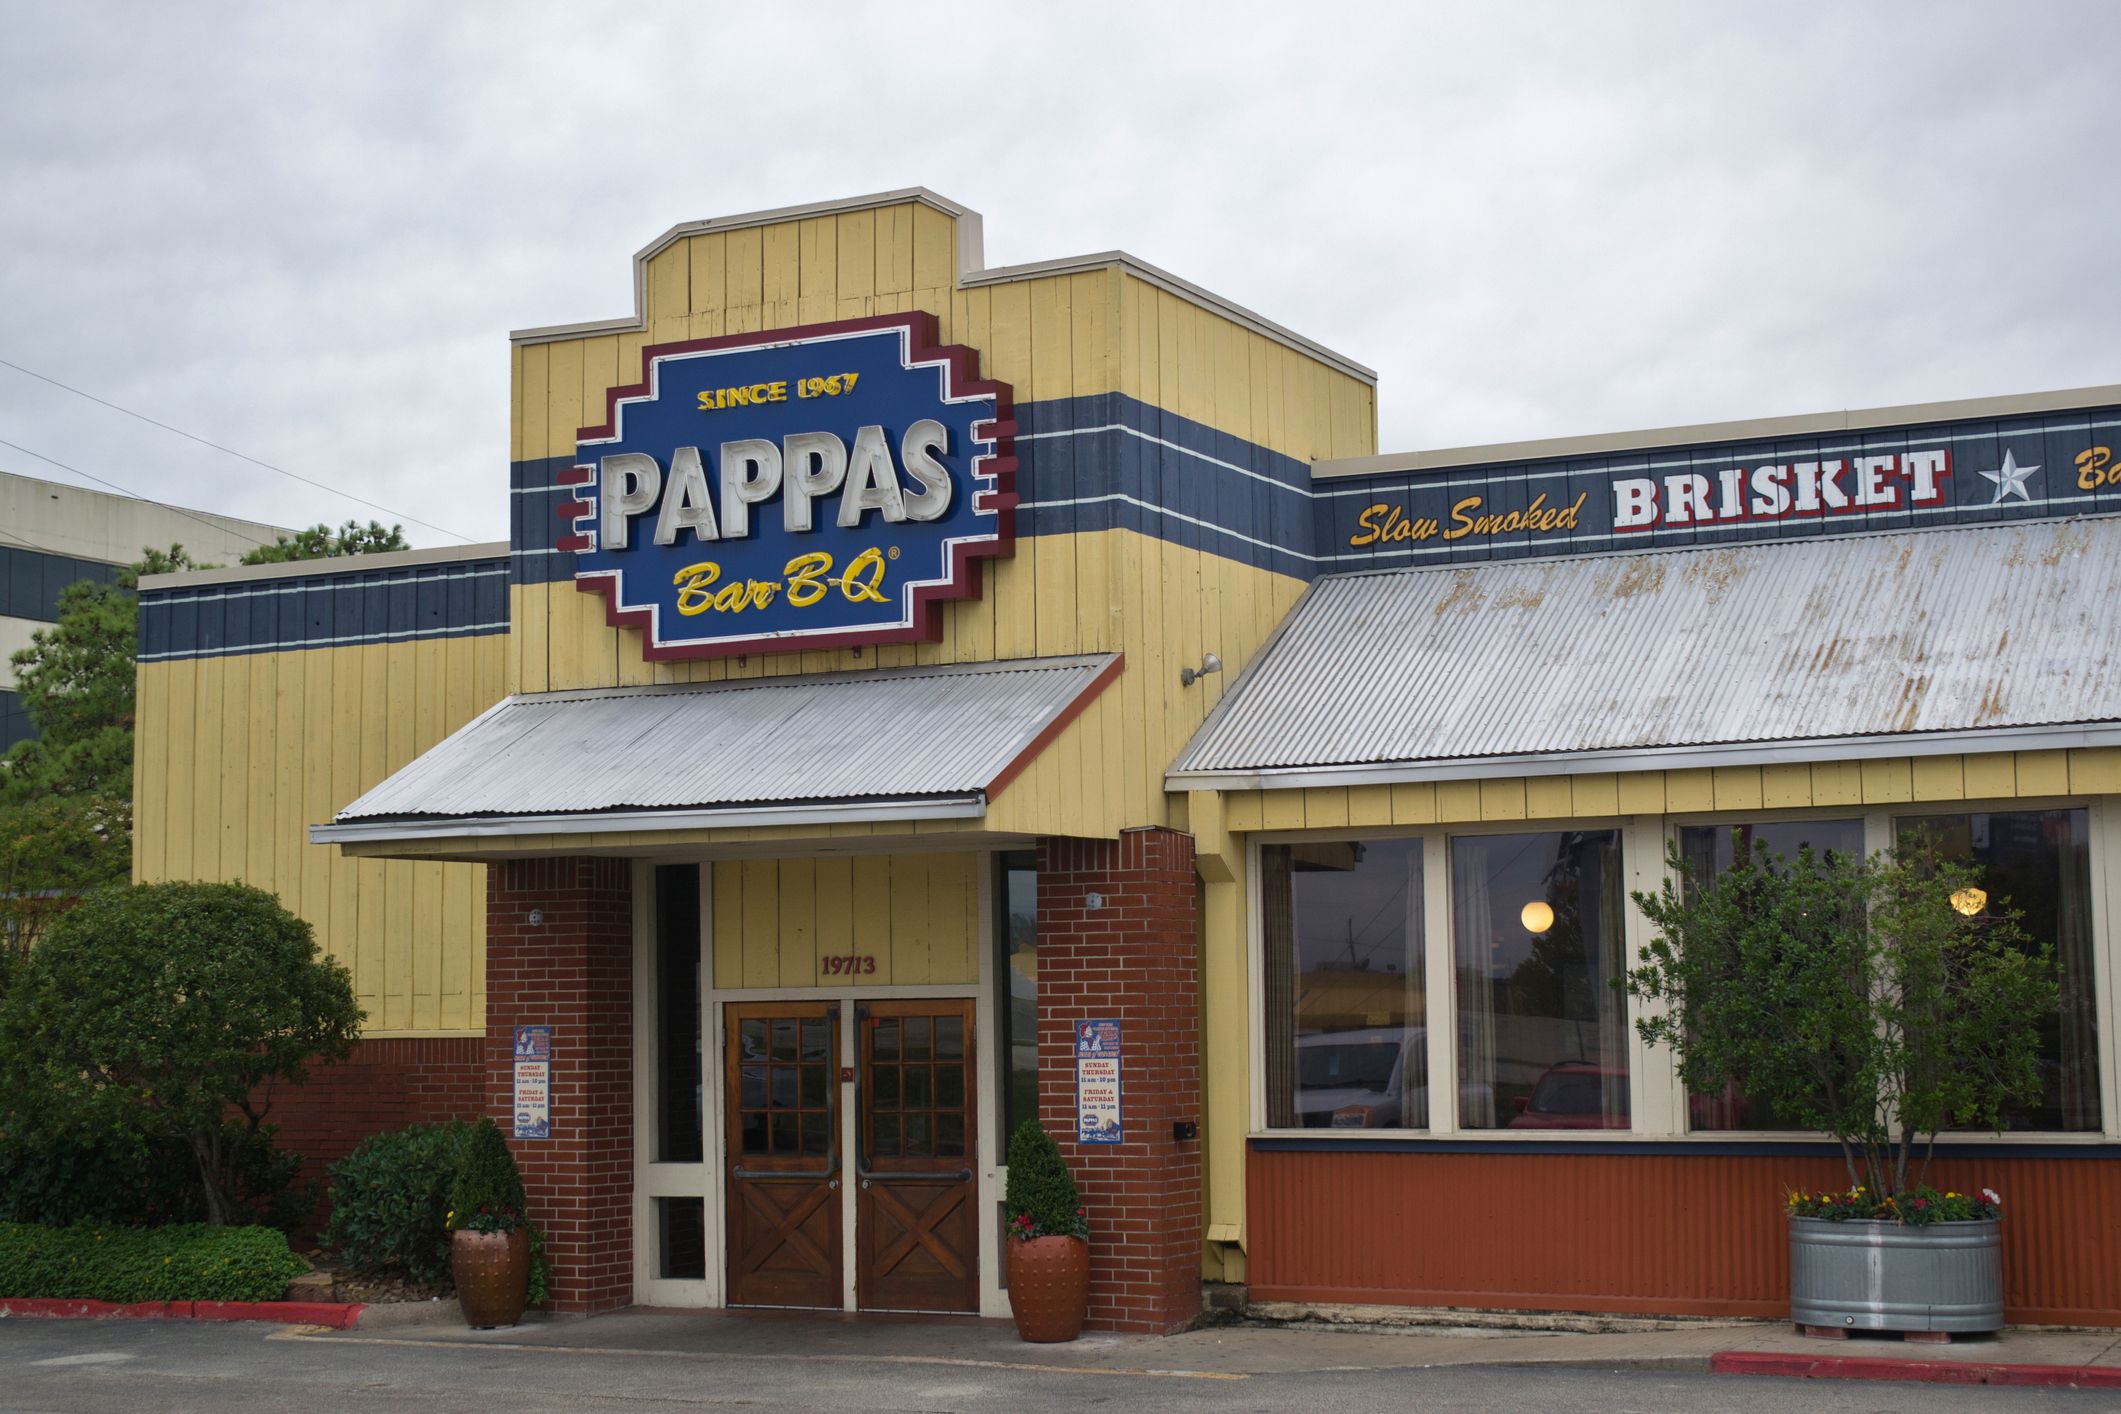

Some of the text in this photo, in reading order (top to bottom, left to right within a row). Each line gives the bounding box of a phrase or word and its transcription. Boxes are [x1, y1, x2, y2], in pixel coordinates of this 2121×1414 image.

[697, 373, 859, 411] SINCE 1967
[601, 419, 953, 550] PAPPAS
[1351, 503, 1438, 545] Slow
[1443, 492, 1588, 540] Smoked
[1612, 449, 1951, 531] BRISKET
[822, 956, 876, 975] 19713
